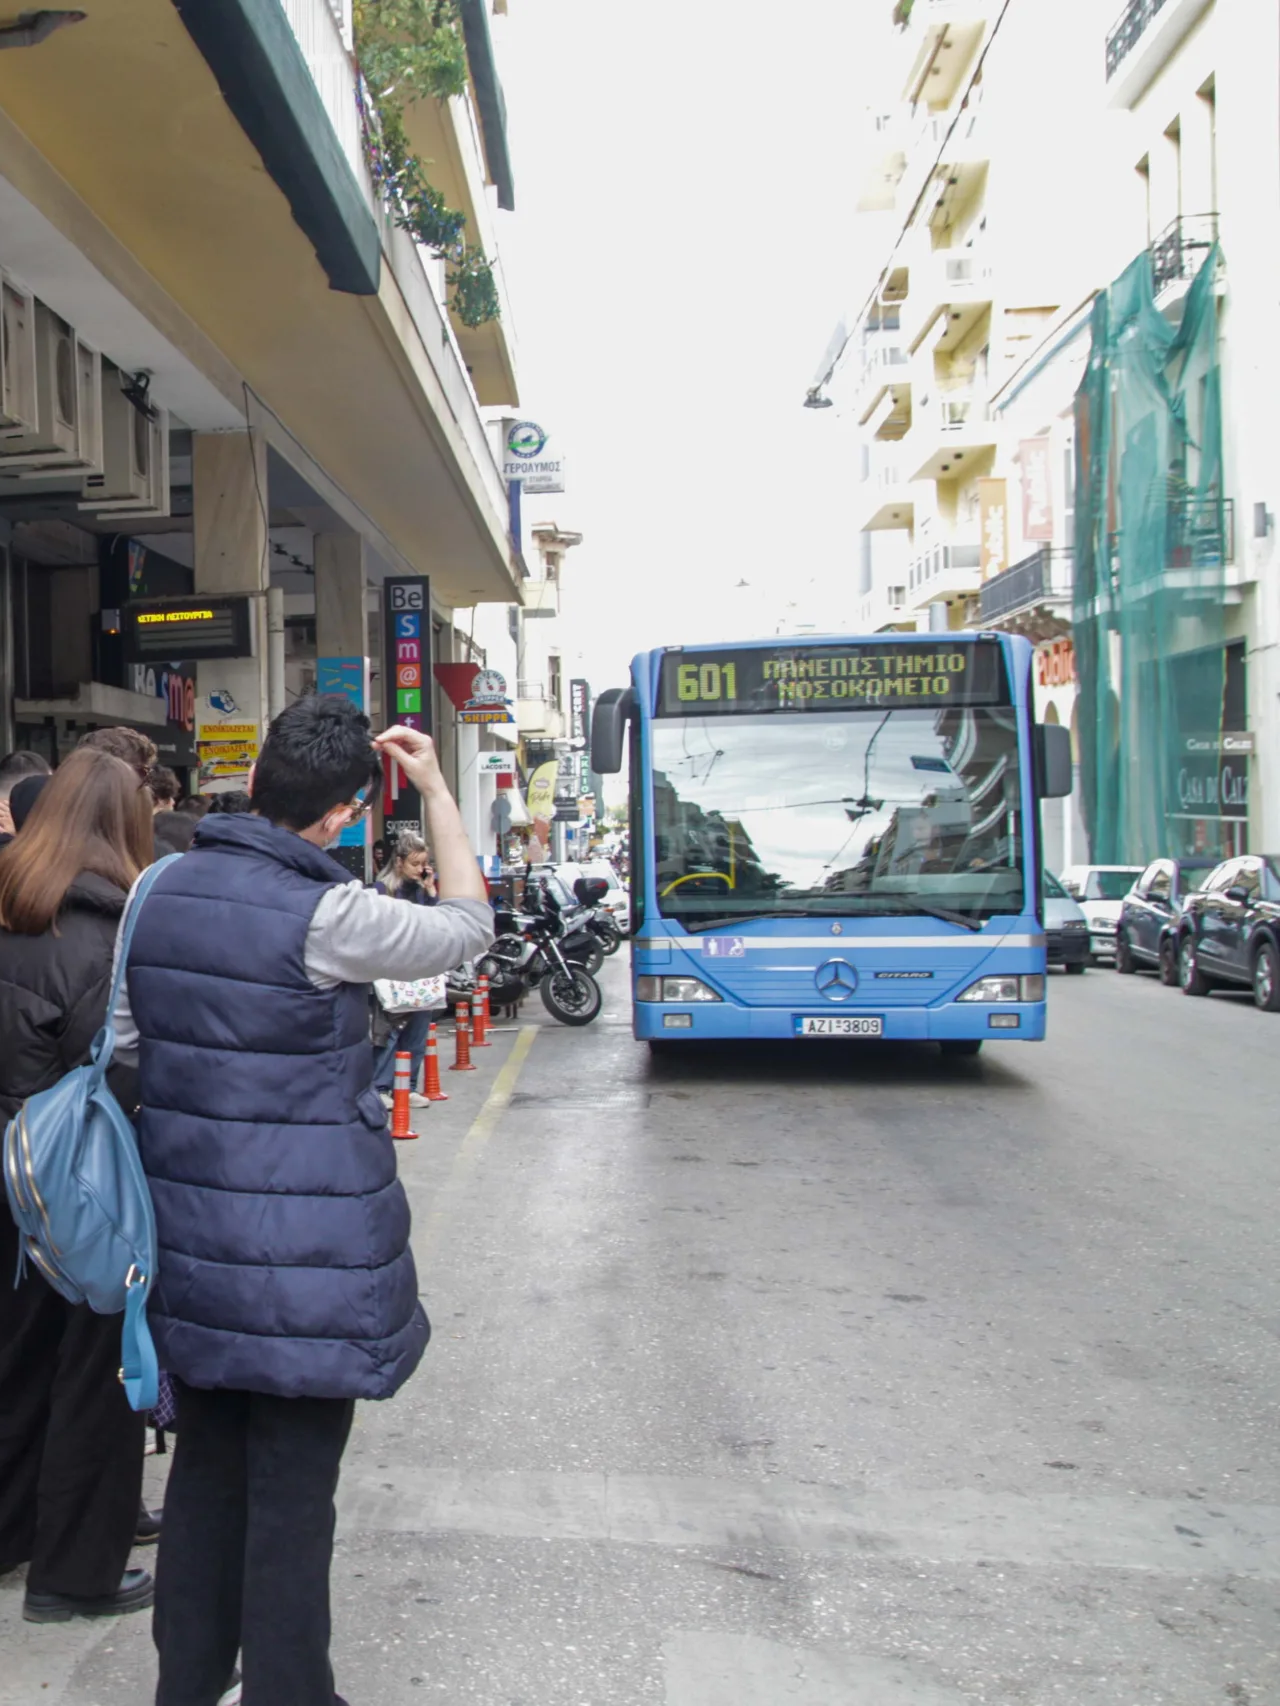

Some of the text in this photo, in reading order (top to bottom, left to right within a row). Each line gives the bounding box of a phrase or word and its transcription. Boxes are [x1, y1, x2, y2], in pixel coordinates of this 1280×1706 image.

[392, 586, 422, 609] Be
[763, 653, 966, 680] ΠΑΝΕΠΙΣΤΗΜΙΟ
[677, 662, 737, 701] 601
[778, 676, 950, 701] ΝΟΣΟΚΟΜΕΙΟ
[808, 1019, 880, 1033] AZI-3809
